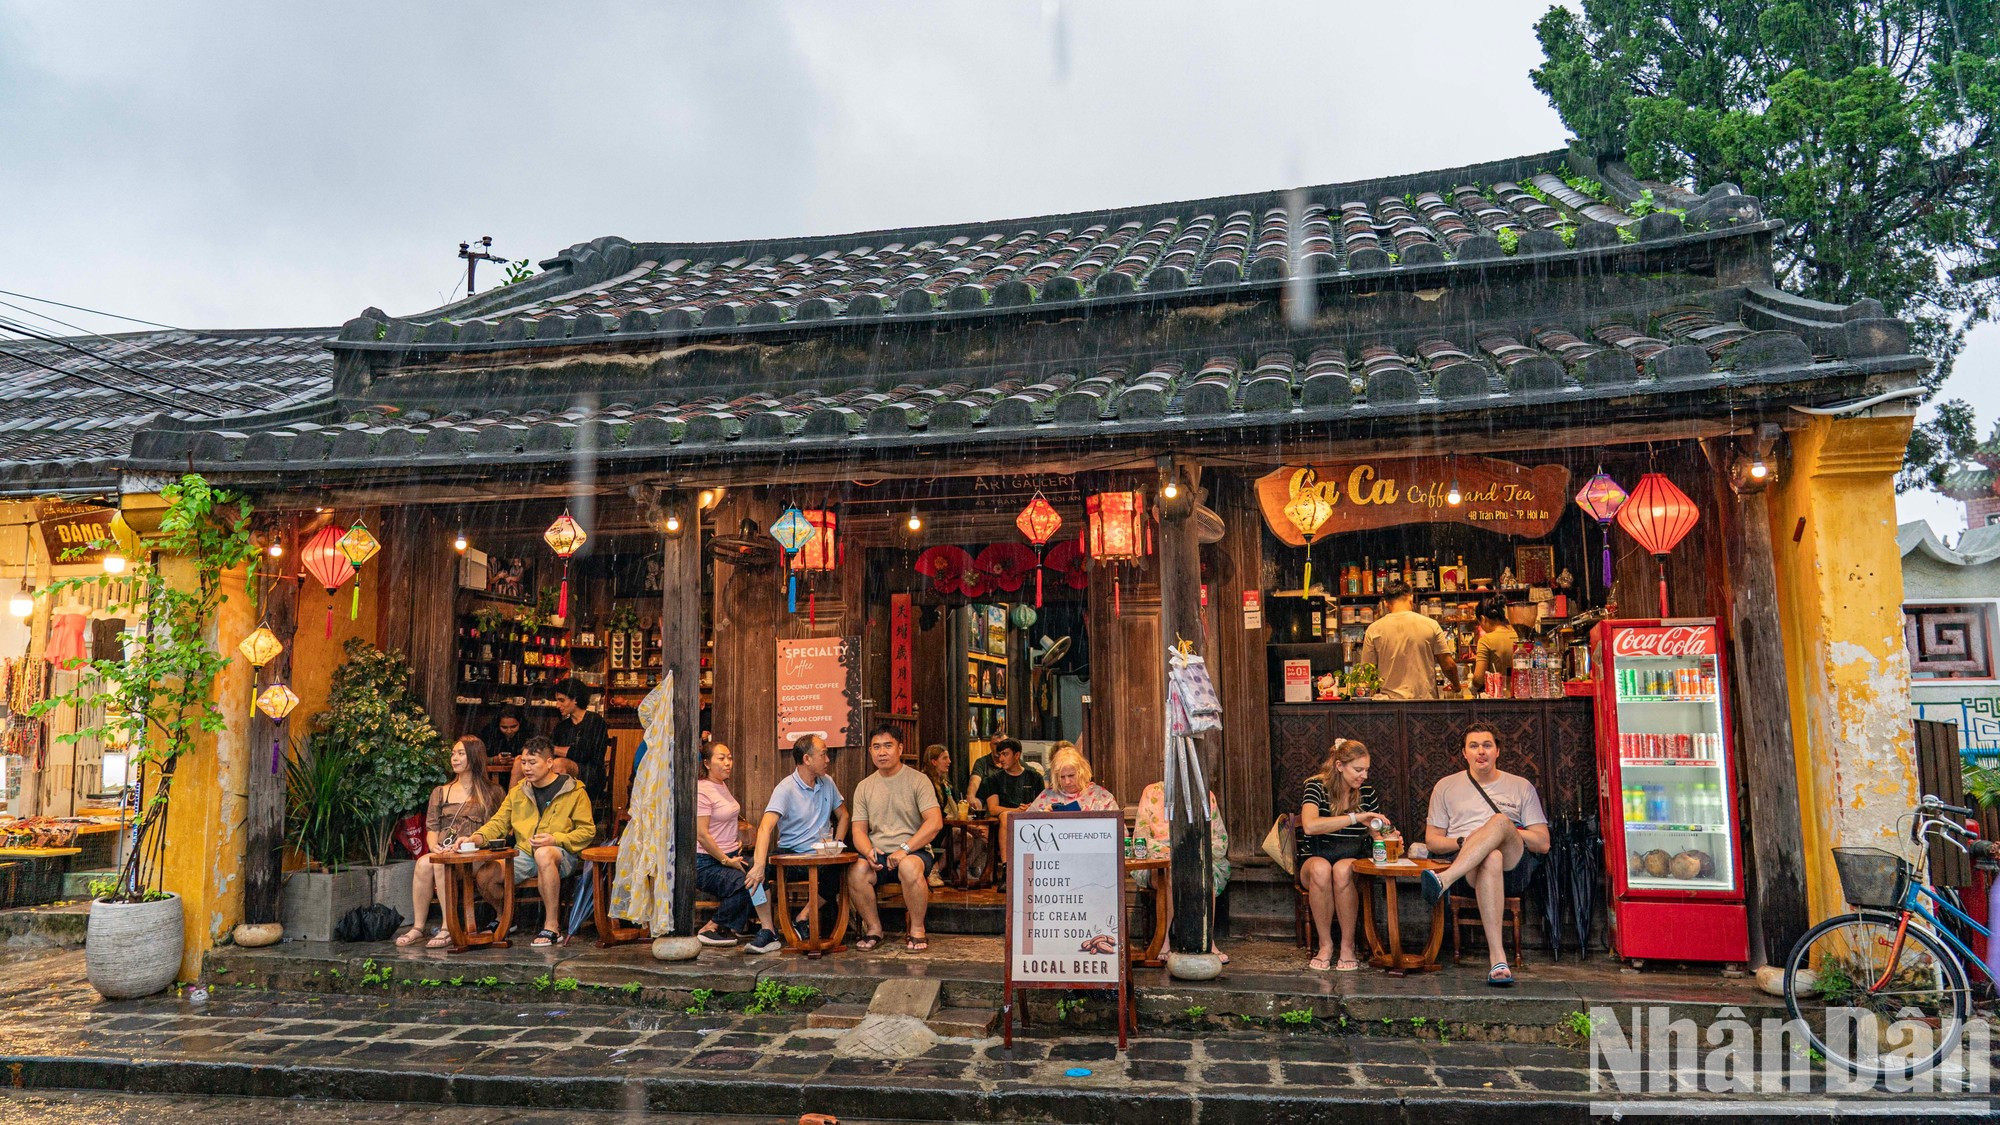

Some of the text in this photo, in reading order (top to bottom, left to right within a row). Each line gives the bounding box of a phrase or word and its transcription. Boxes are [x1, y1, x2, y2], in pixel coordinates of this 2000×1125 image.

[1012, 476, 1077, 488] GALLERY
[1348, 465, 1399, 505] Ca
[1407, 481, 1456, 508] Coff
[1464, 482, 1499, 502] and
[1503, 484, 1535, 502] Tea
[1540, 510, 1549, 520] An
[57, 521, 105, 543] ĐĂNG
[1613, 626, 1710, 656] Coca-Cola
[786, 646, 848, 658] SPECIALTY
[785, 658, 814, 677] Coffee
[782, 683, 813, 691] COCONUT
[796, 693, 820, 701] COFFEE
[1058, 832, 1082, 840] COFFEE
[1083, 832, 1098, 840] AND
[1028, 860, 1060, 870] JUICE
[1028, 877, 1070, 887] YOGURT
[1027, 894, 1084, 904] SMOOTHIE
[1028, 911, 1087, 921] ICE CREAM
[1028, 928, 1092, 938] FRUIT SODA
[1023, 960, 1109, 974] LOCAL BEER
